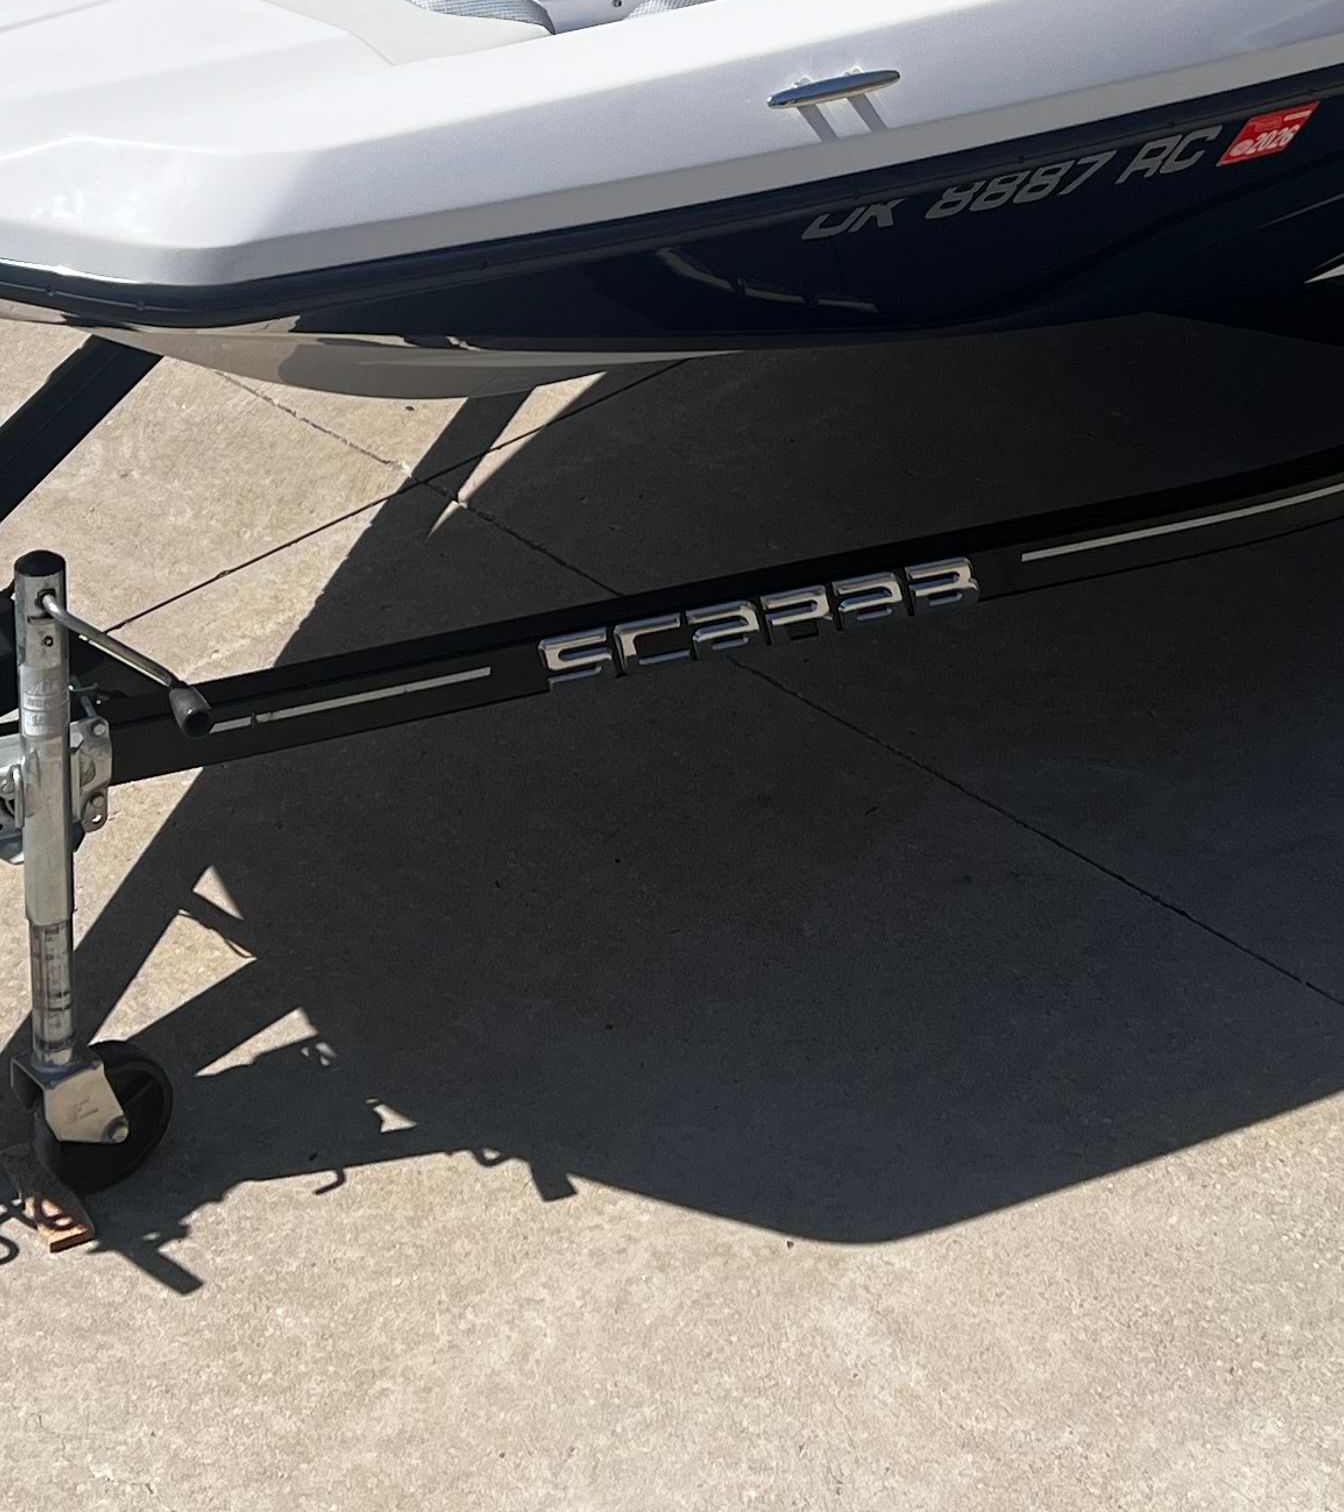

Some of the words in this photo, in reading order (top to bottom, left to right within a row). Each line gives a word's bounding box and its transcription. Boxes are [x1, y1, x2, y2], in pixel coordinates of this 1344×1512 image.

[1245, 124, 1301, 156] 2026
[924, 149, 1118, 220] 8887
[538, 556, 979, 683] SCARAB
